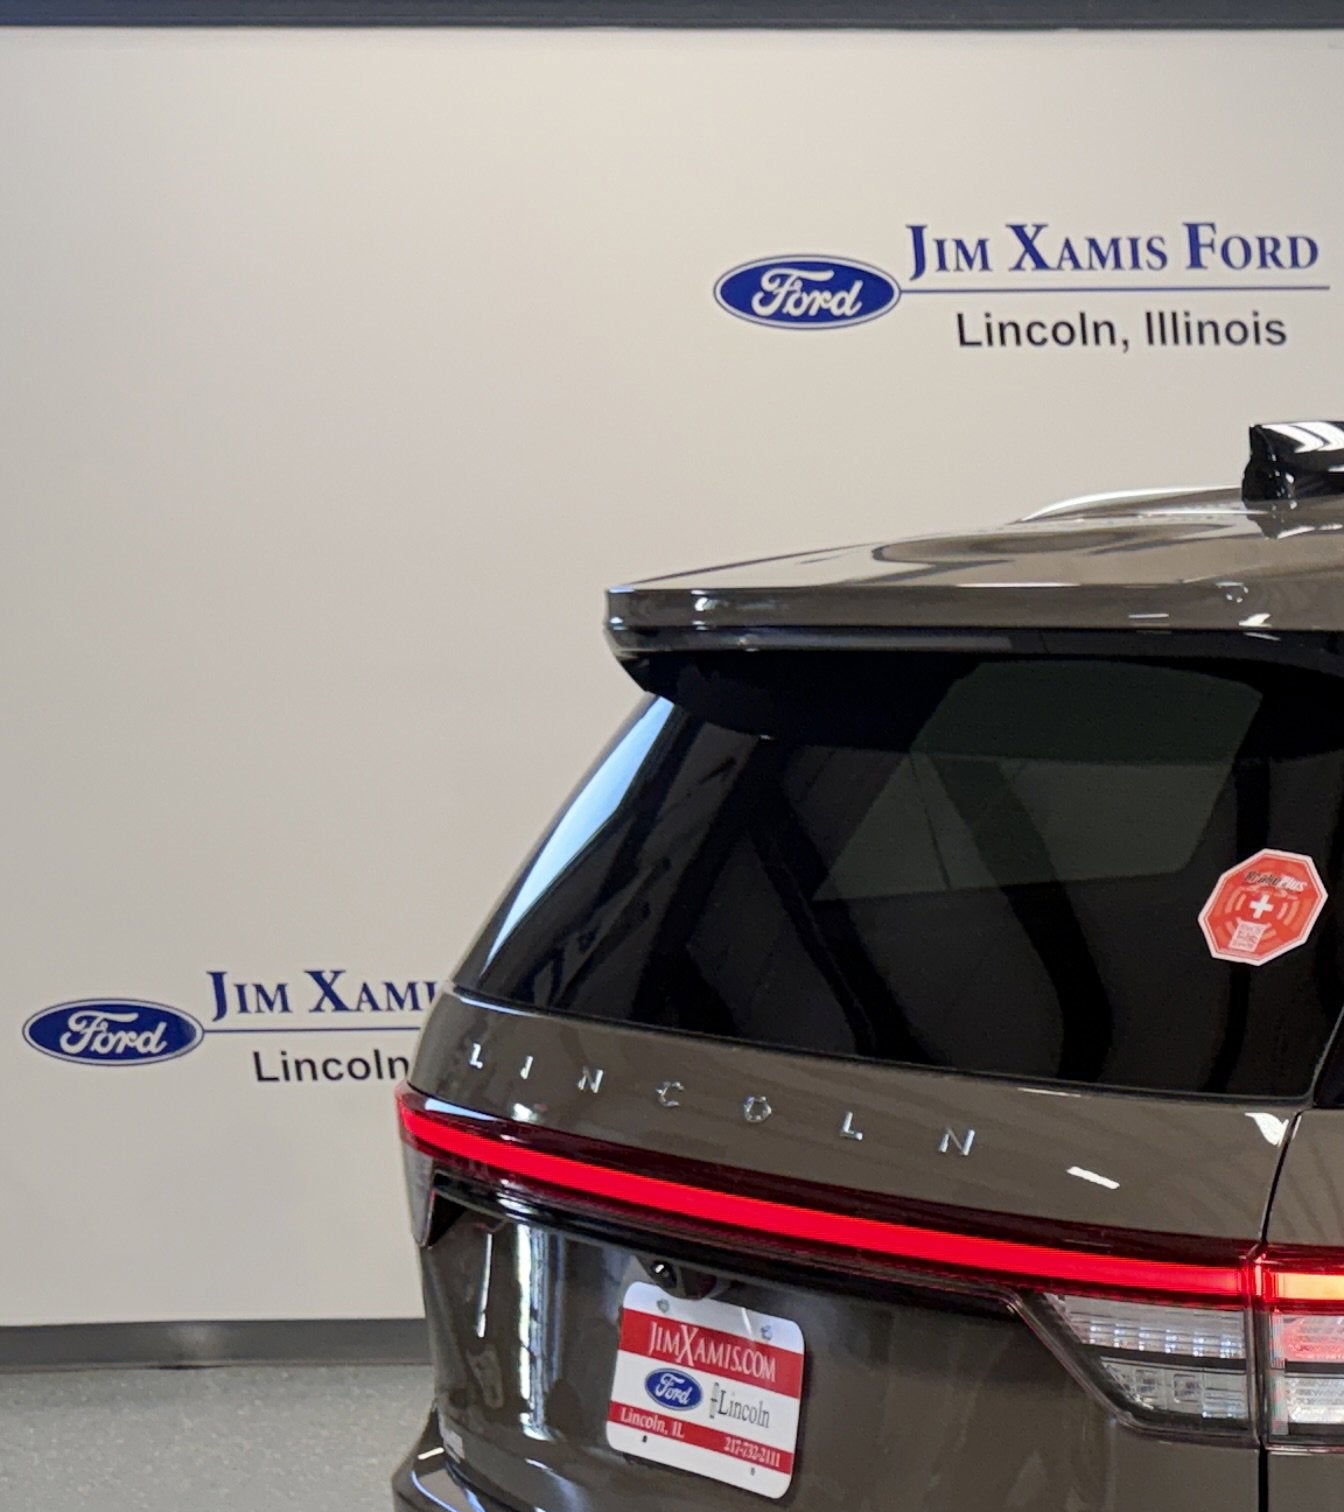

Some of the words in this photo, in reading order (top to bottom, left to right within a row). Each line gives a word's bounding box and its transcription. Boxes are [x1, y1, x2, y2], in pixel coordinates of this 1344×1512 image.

[906, 224, 991, 281] JIM
[1005, 223, 1168, 272] XAMIS
[1182, 221, 1319, 270] FORD
[956, 310, 1130, 353] Lincoln,
[1145, 309, 1287, 347] Illinois
[206, 970, 292, 1022] JIM
[303, 968, 438, 1014] XAMI
[468, 1041, 976, 1157] LINCOLN
[717, 1389, 771, 1429] Lincoln
